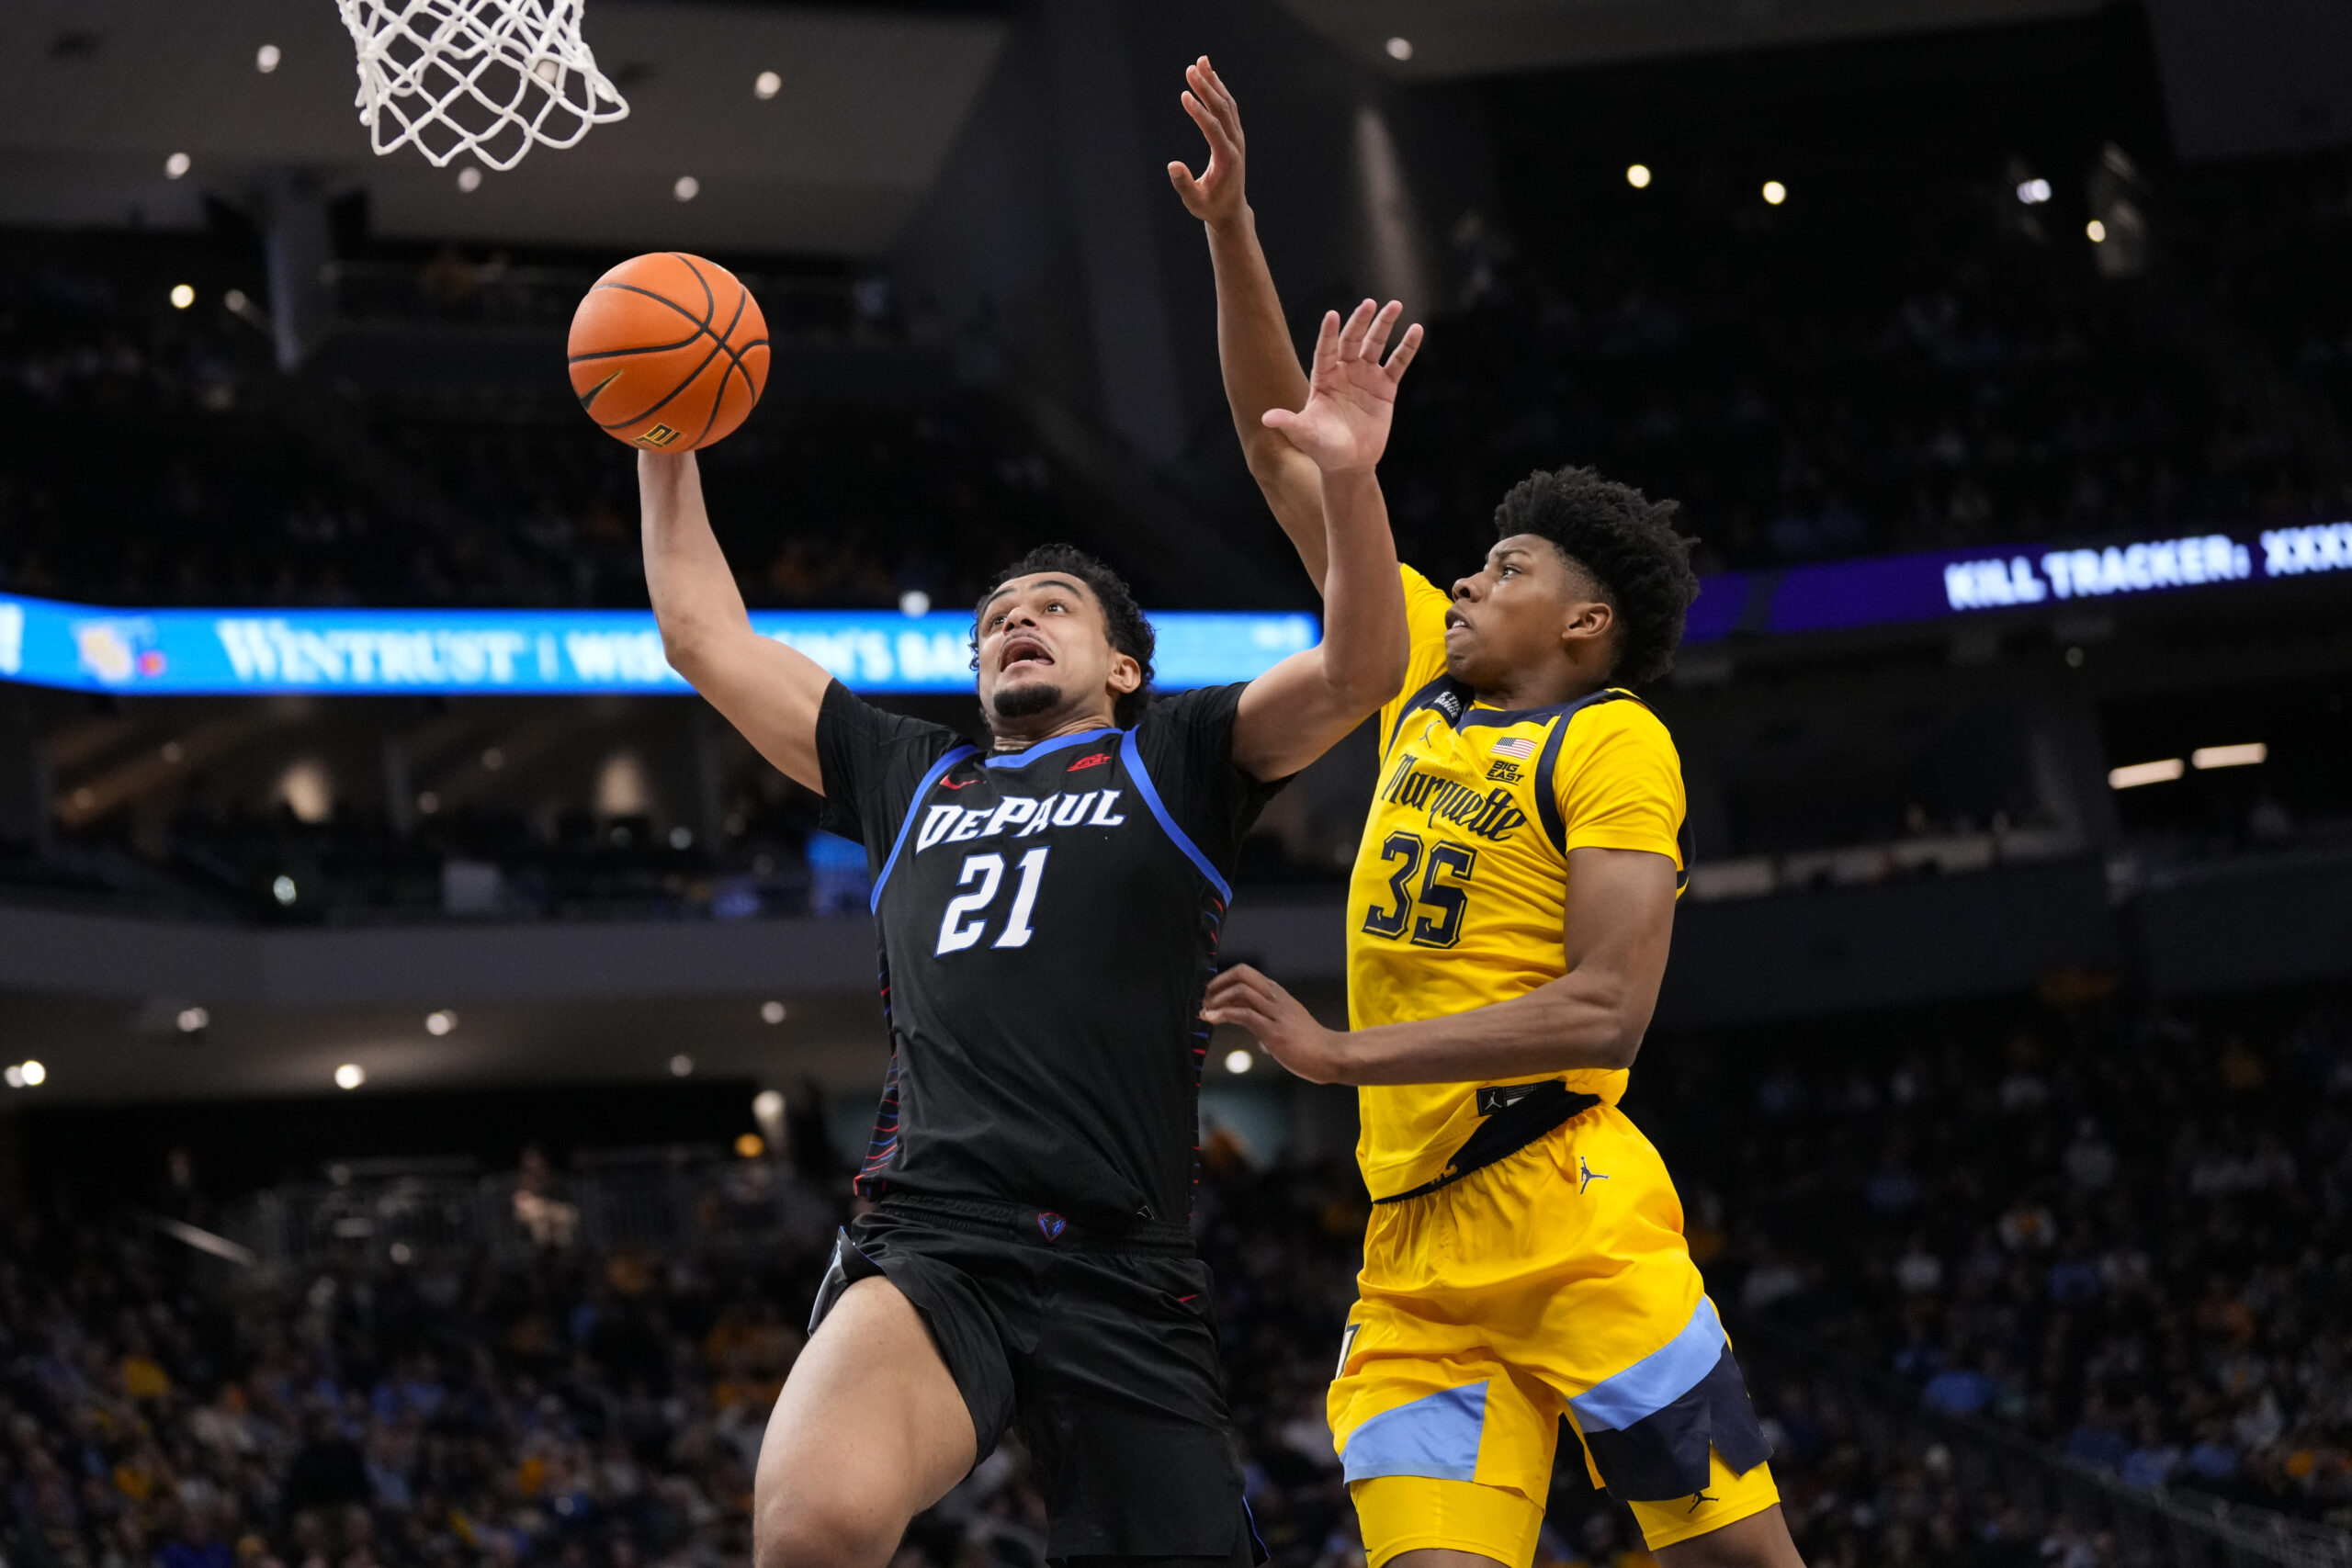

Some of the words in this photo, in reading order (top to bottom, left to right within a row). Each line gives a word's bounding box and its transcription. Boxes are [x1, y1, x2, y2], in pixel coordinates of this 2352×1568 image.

[1944, 555, 2047, 611] KILL
[2041, 534, 2251, 599] TRACKER:
[1380, 752, 1527, 842] Marquette
[1486, 768, 1525, 784] EAST
[1492, 760, 1521, 773] BIG
[933, 845, 1051, 958] 21
[1361, 829, 1478, 950] 35
